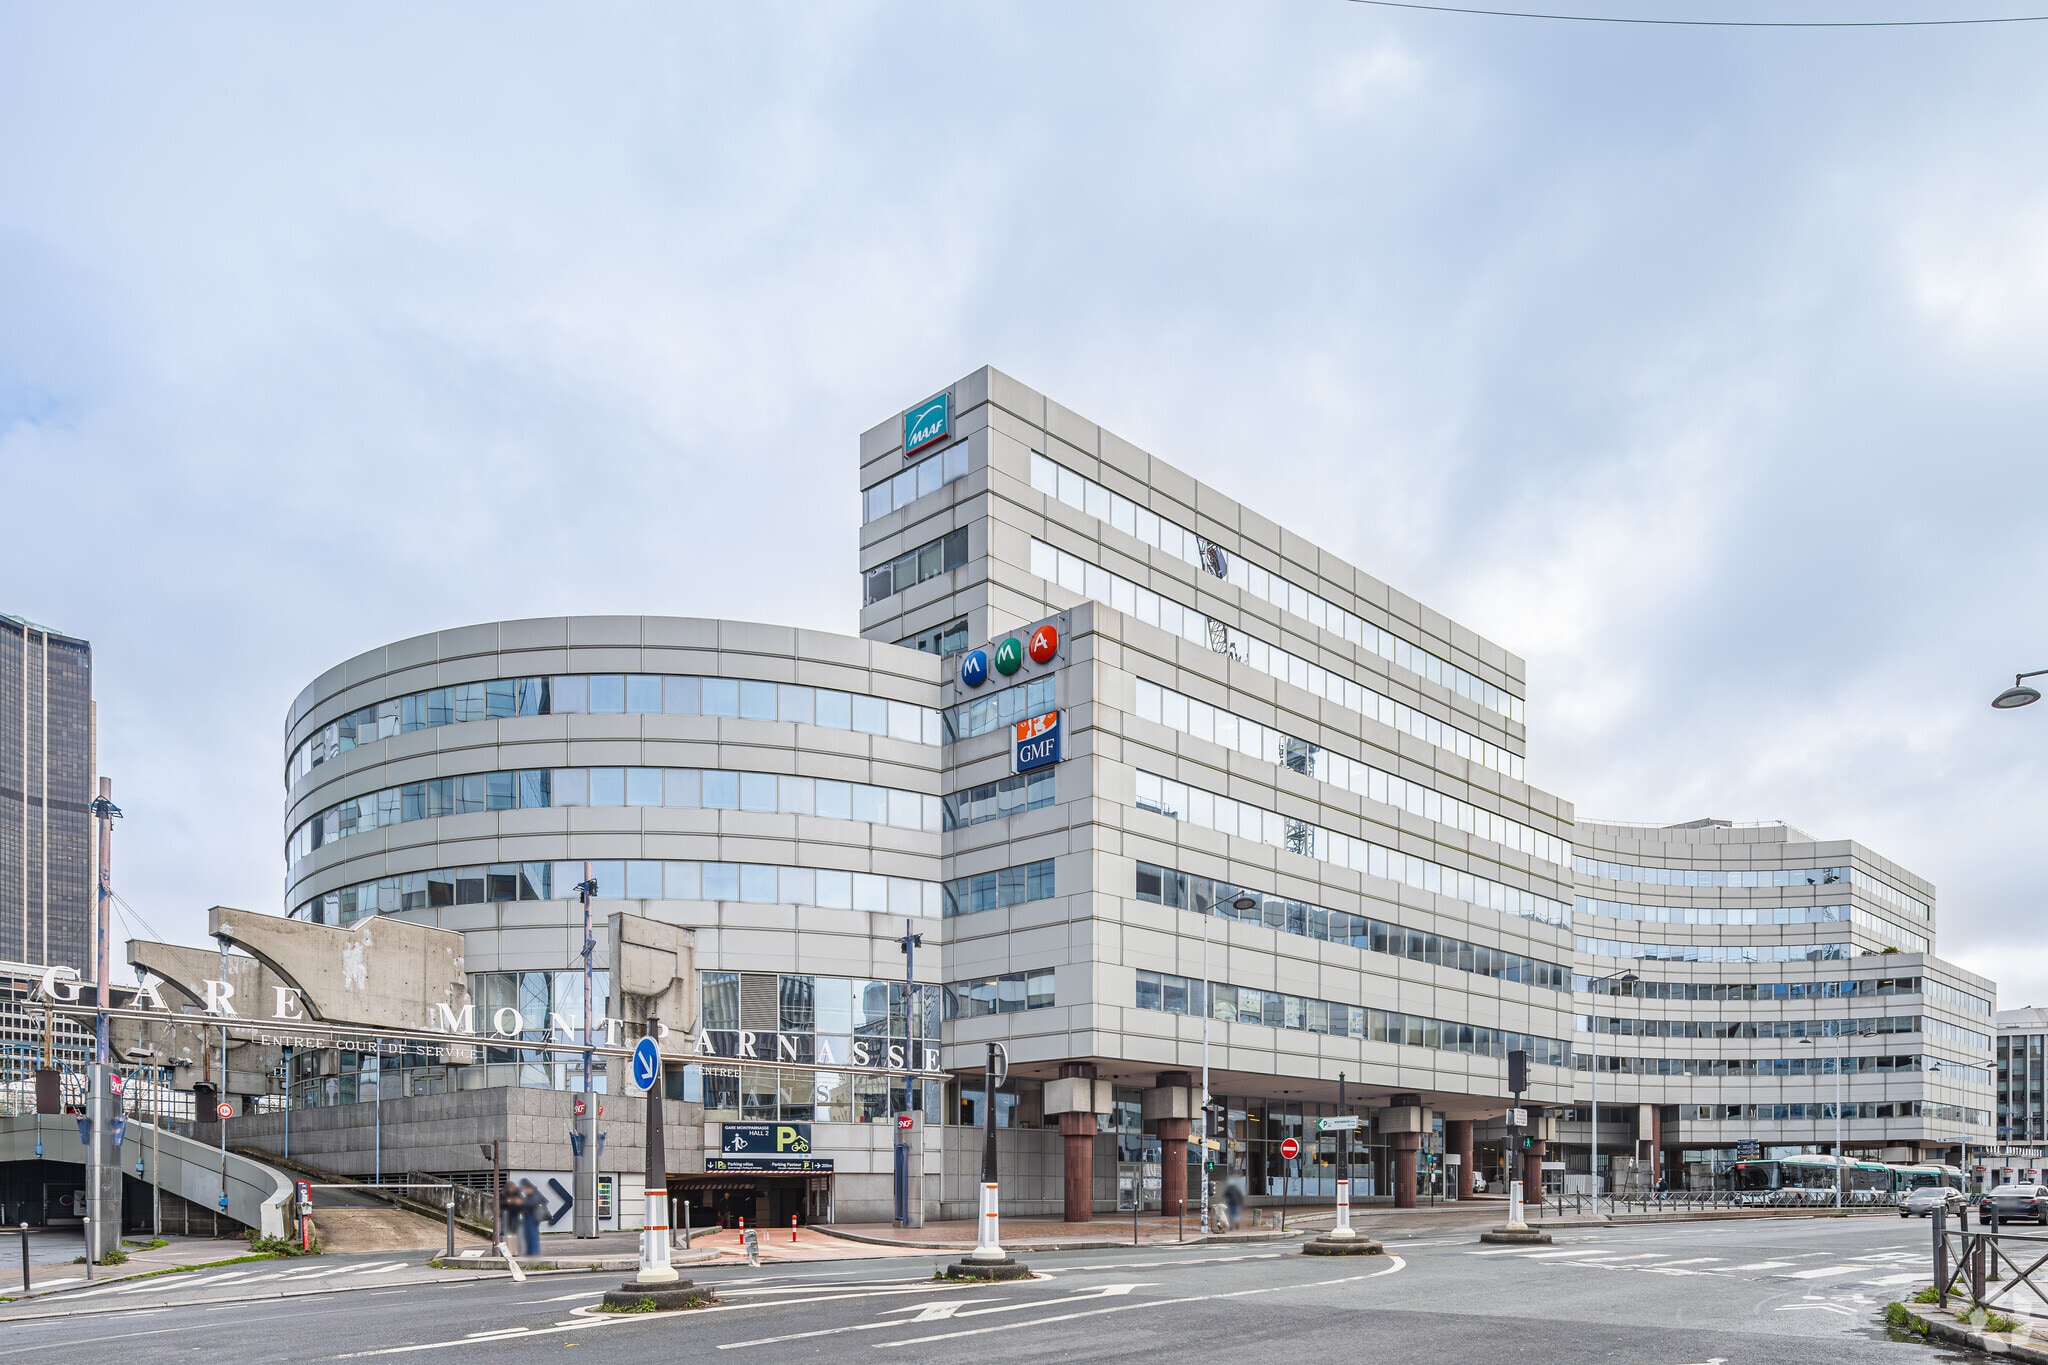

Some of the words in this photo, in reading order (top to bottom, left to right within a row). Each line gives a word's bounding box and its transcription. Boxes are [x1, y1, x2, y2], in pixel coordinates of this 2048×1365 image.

[909, 419, 943, 446] MAAF
[1020, 738, 1055, 763] GMF
[42, 965, 303, 1020] GARE
[261, 1034, 325, 1049] ENTREE
[336, 1040, 377, 1052] COUR
[388, 1043, 407, 1054] DE
[416, 1045, 478, 1060] SERVICE
[698, 1066, 741, 1078] ENTREE
[898, 1120, 912, 1128] SNCF
[777, 1126, 797, 1152] P
